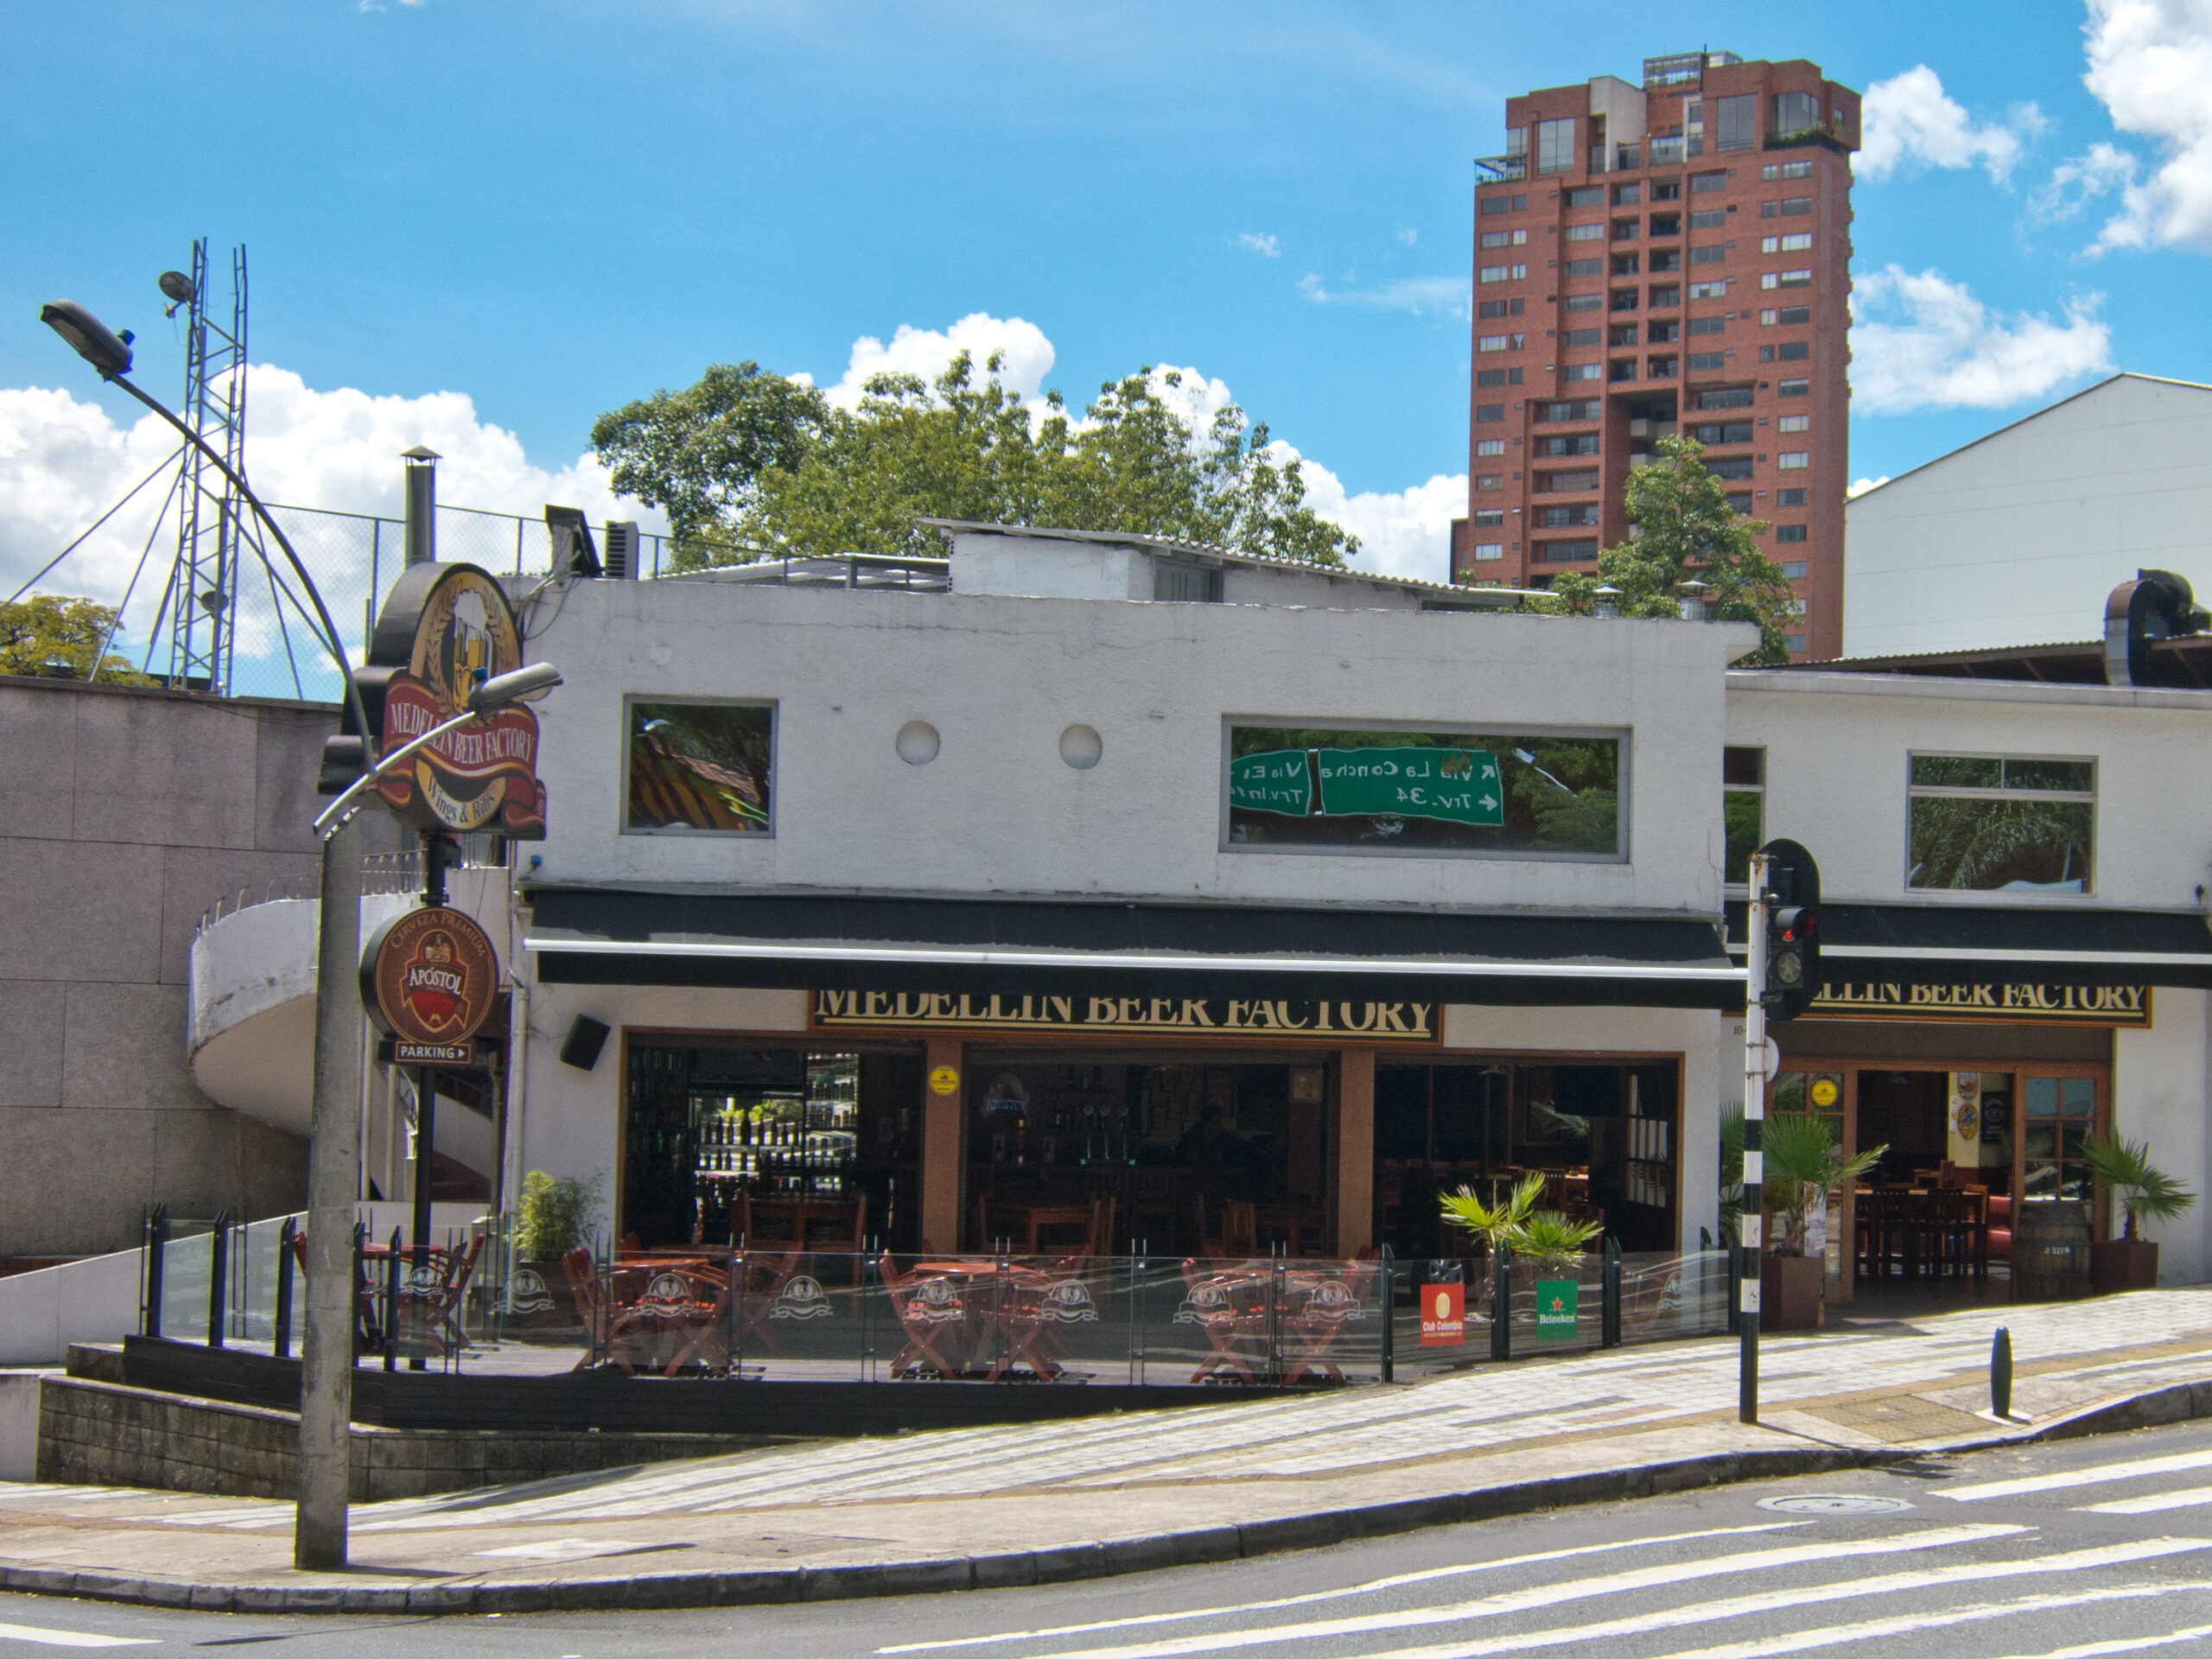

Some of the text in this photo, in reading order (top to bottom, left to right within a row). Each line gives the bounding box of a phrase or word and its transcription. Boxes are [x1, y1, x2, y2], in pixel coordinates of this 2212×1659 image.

[454, 732, 484, 764] BEER
[486, 728, 534, 762] FACTORY
[428, 774, 457, 823] Wings
[460, 803, 469, 823] &
[391, 912, 486, 957] CERVEZA PREMIUM
[815, 990, 1431, 1033] MEDELLIN BEER FACTORY
[1909, 984, 1997, 1006] BEER
[2002, 984, 2145, 1010] FACTORY
[401, 1046, 455, 1058] PARKING
[1424, 1321, 1436, 1332] Club
[1539, 1313, 1575, 1325] Heineken
